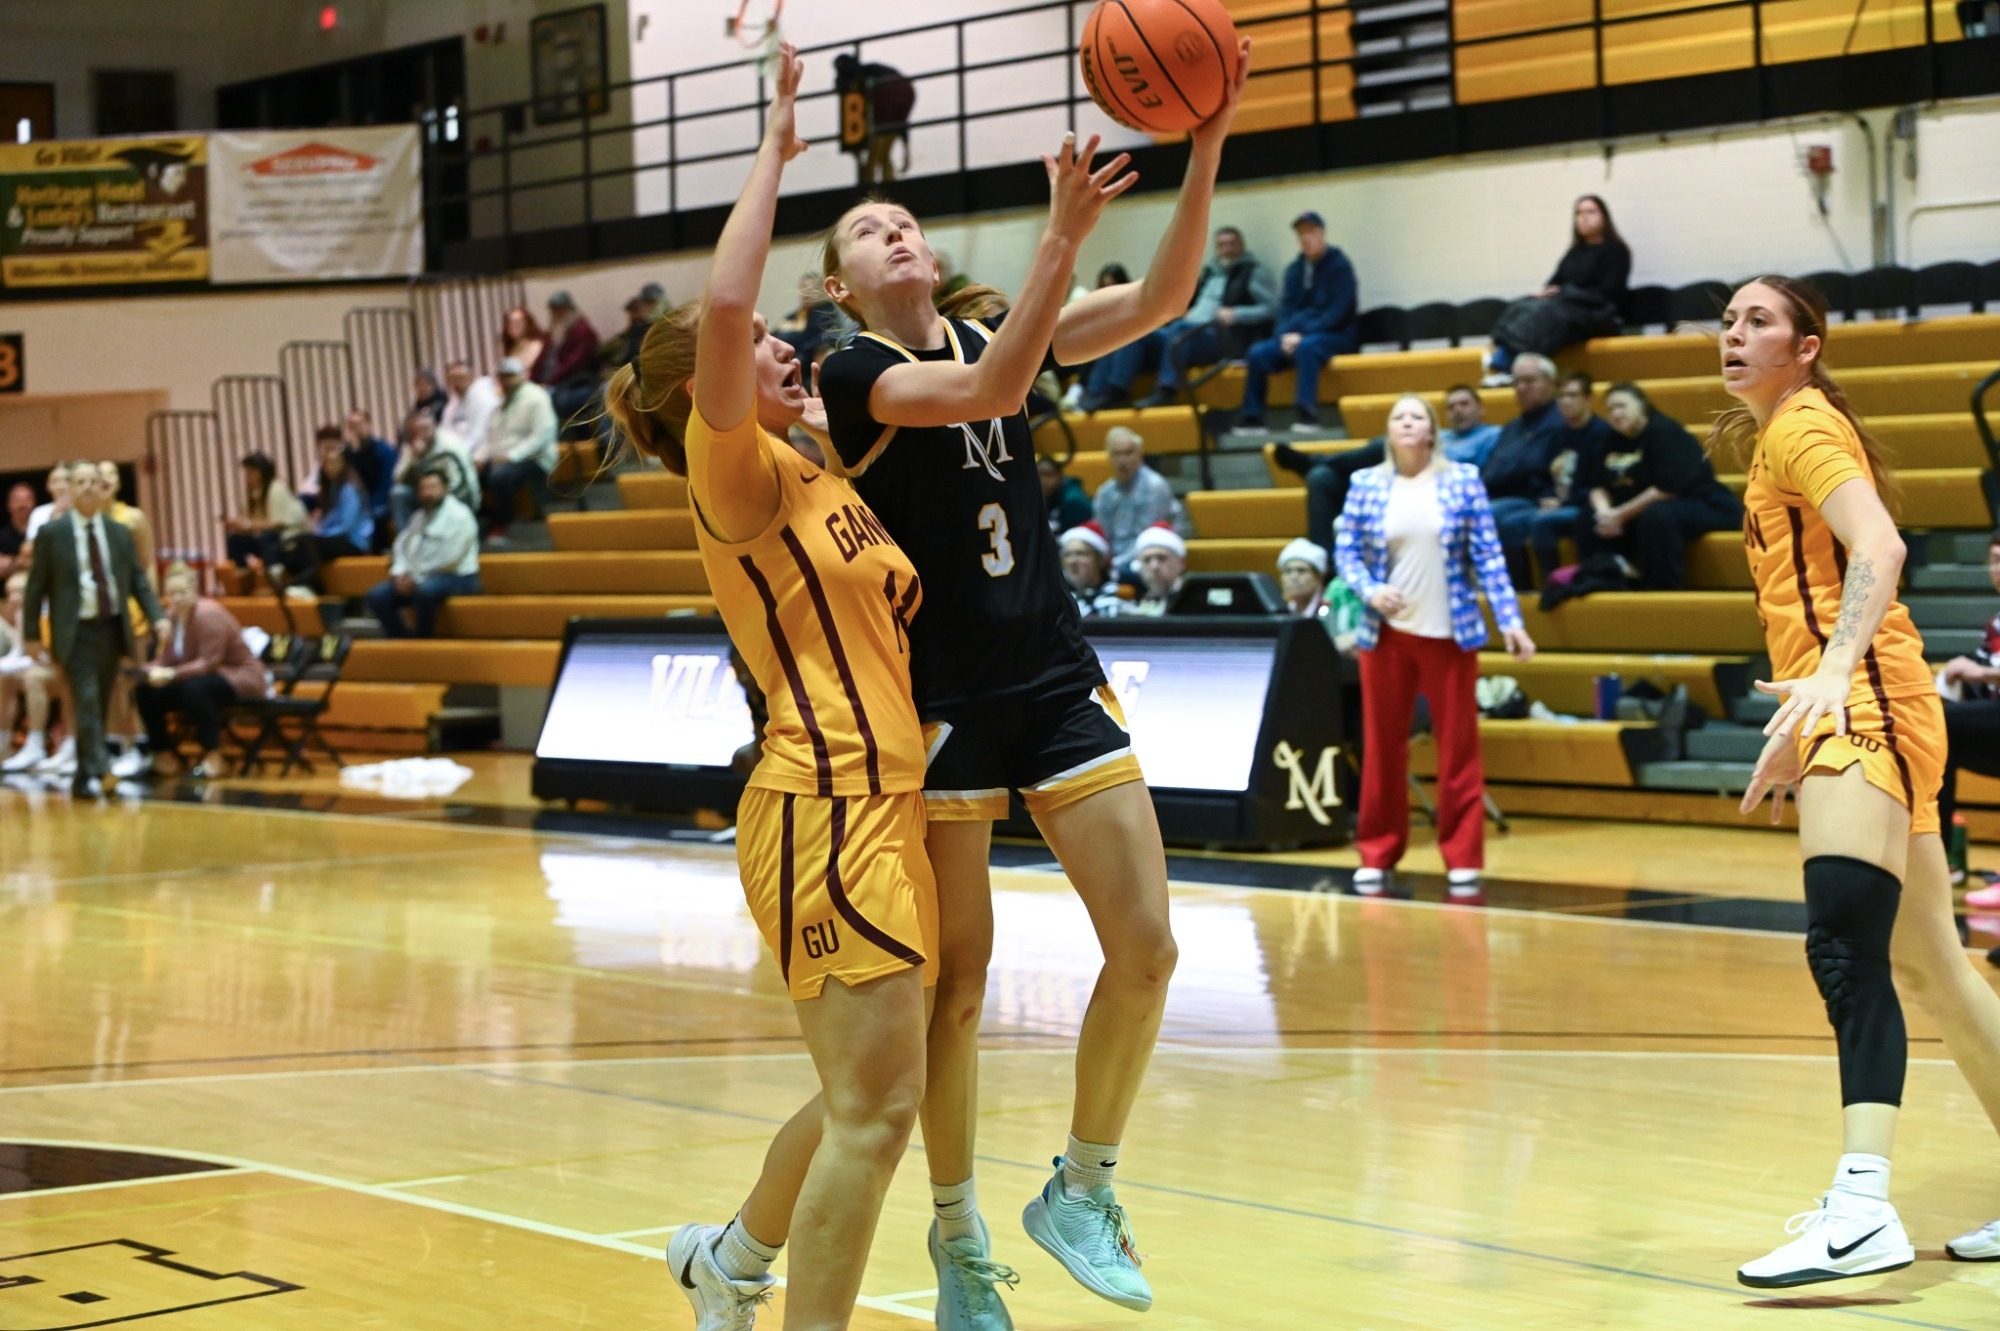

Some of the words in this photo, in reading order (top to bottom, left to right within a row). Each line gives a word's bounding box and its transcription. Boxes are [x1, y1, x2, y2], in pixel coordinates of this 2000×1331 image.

[843, 92, 866, 144] B
[977, 502, 1015, 578] 3
[1273, 740, 1343, 826] M
[801, 918, 840, 959] GU
